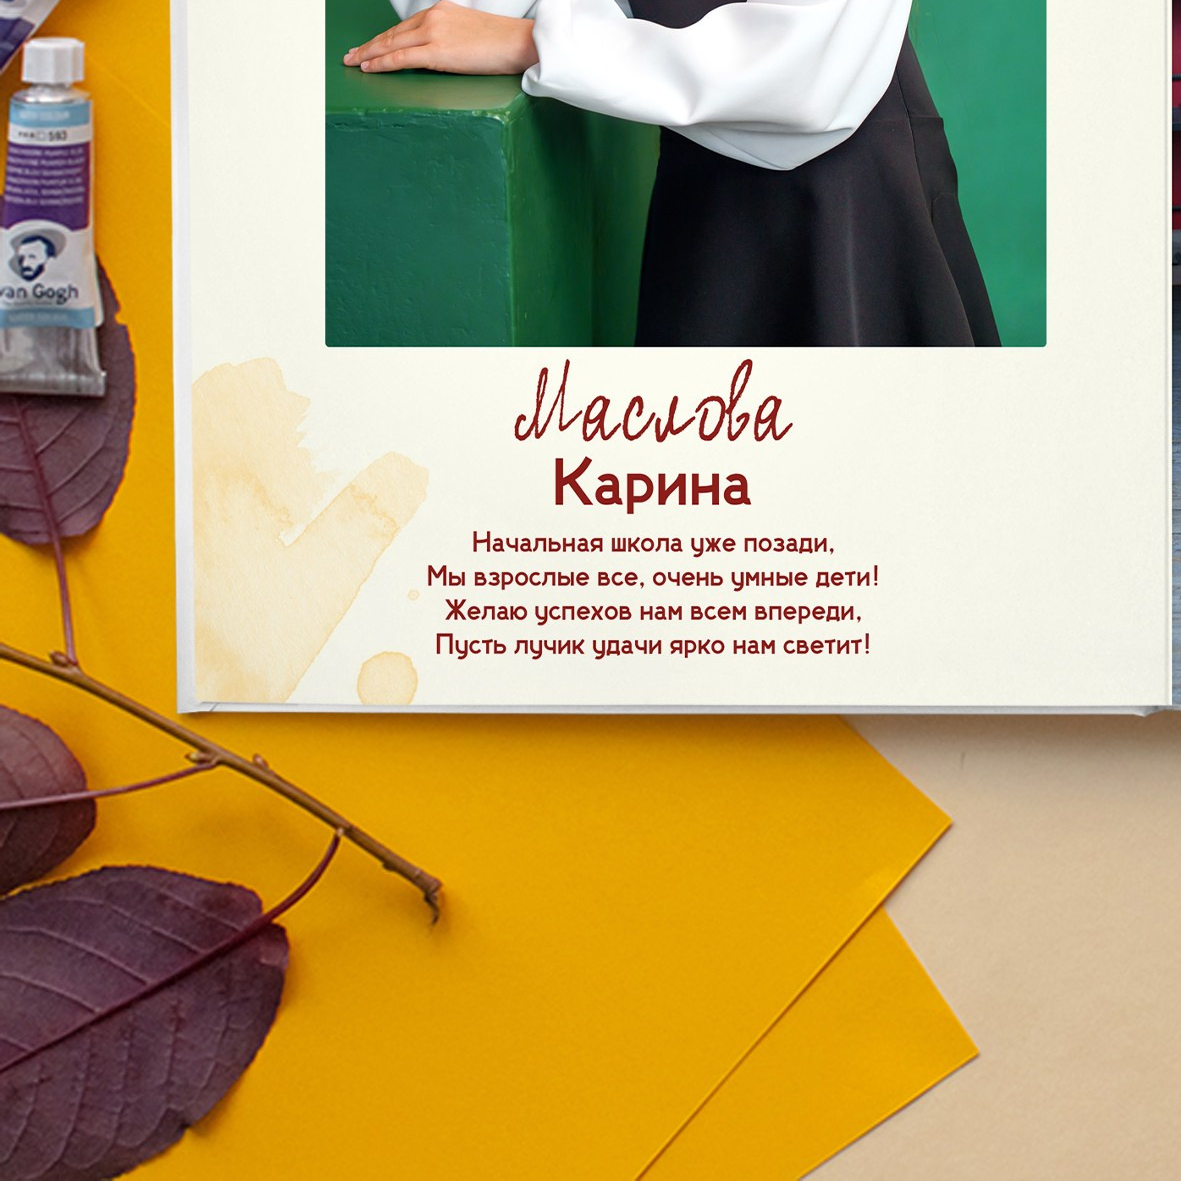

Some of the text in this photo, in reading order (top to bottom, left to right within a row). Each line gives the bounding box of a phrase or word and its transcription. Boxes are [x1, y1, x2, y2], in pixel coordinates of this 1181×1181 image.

[32, 282, 79, 306] Gogh
[514, 358, 794, 443] Маслова
[555, 456, 752, 515] Карина
[473, 530, 834, 558] Начальная школа уже позади,
[427, 565, 878, 592] Мы взрослые все, очень умные дети!
[445, 599, 862, 625] Желаю успехов нам всем впереди,
[436, 633, 870, 659] Пусть лучик удачи ярко нам светит!
